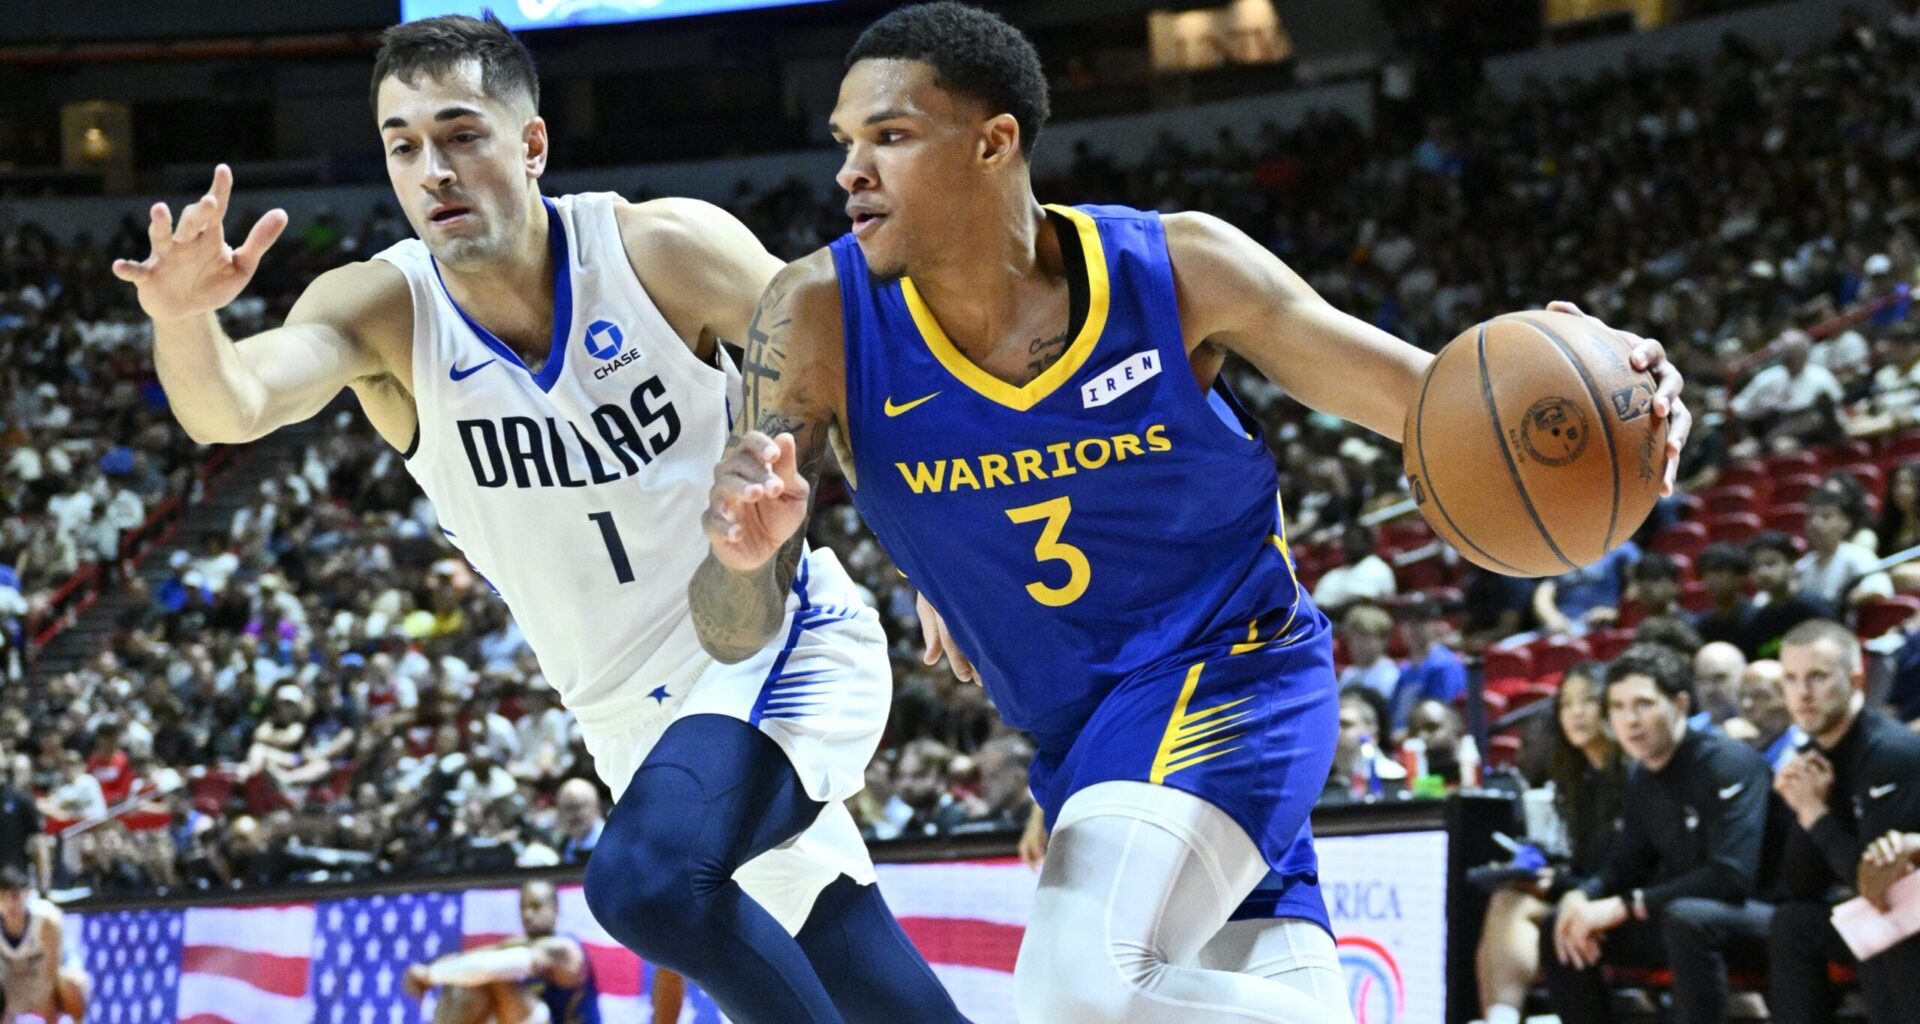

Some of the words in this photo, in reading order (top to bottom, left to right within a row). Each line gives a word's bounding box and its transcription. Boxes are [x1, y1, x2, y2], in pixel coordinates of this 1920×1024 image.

[593, 348, 641, 380] CHASE
[1089, 356, 1153, 402] IREN
[456, 375, 681, 488] DALLAS
[895, 424, 1172, 494] WARRIORS
[588, 511, 635, 584] 1
[1004, 496, 1091, 606] 3
[1320, 881, 1402, 920] RICA
